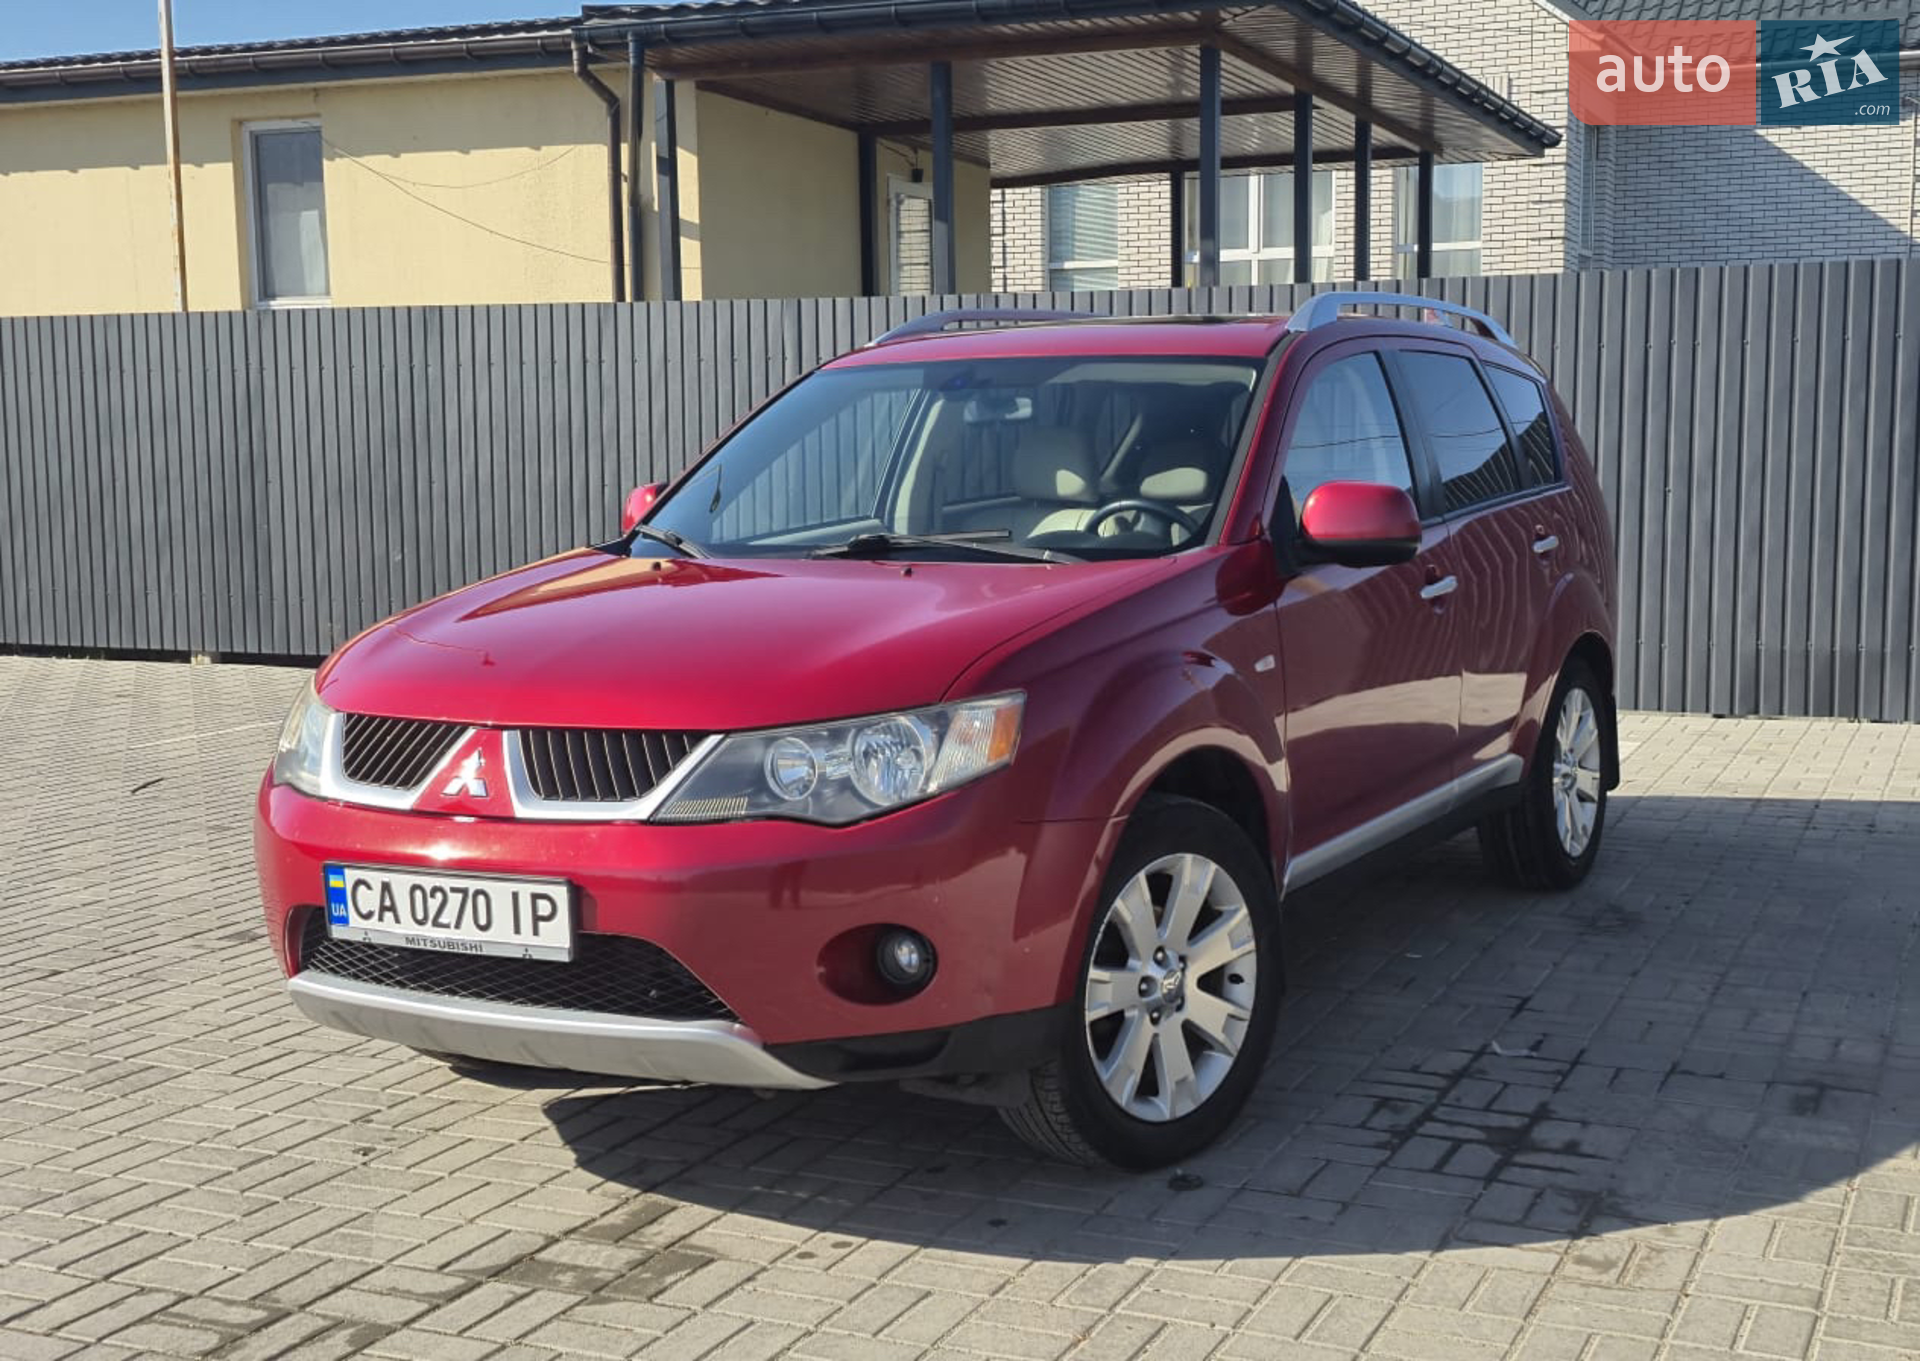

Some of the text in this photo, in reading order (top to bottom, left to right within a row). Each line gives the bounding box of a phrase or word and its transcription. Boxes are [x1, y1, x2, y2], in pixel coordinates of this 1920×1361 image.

[332, 903, 347, 917] UA
[351, 878, 558, 937] CA 0270 IP
[405, 936, 484, 953] MITSUBISHI
